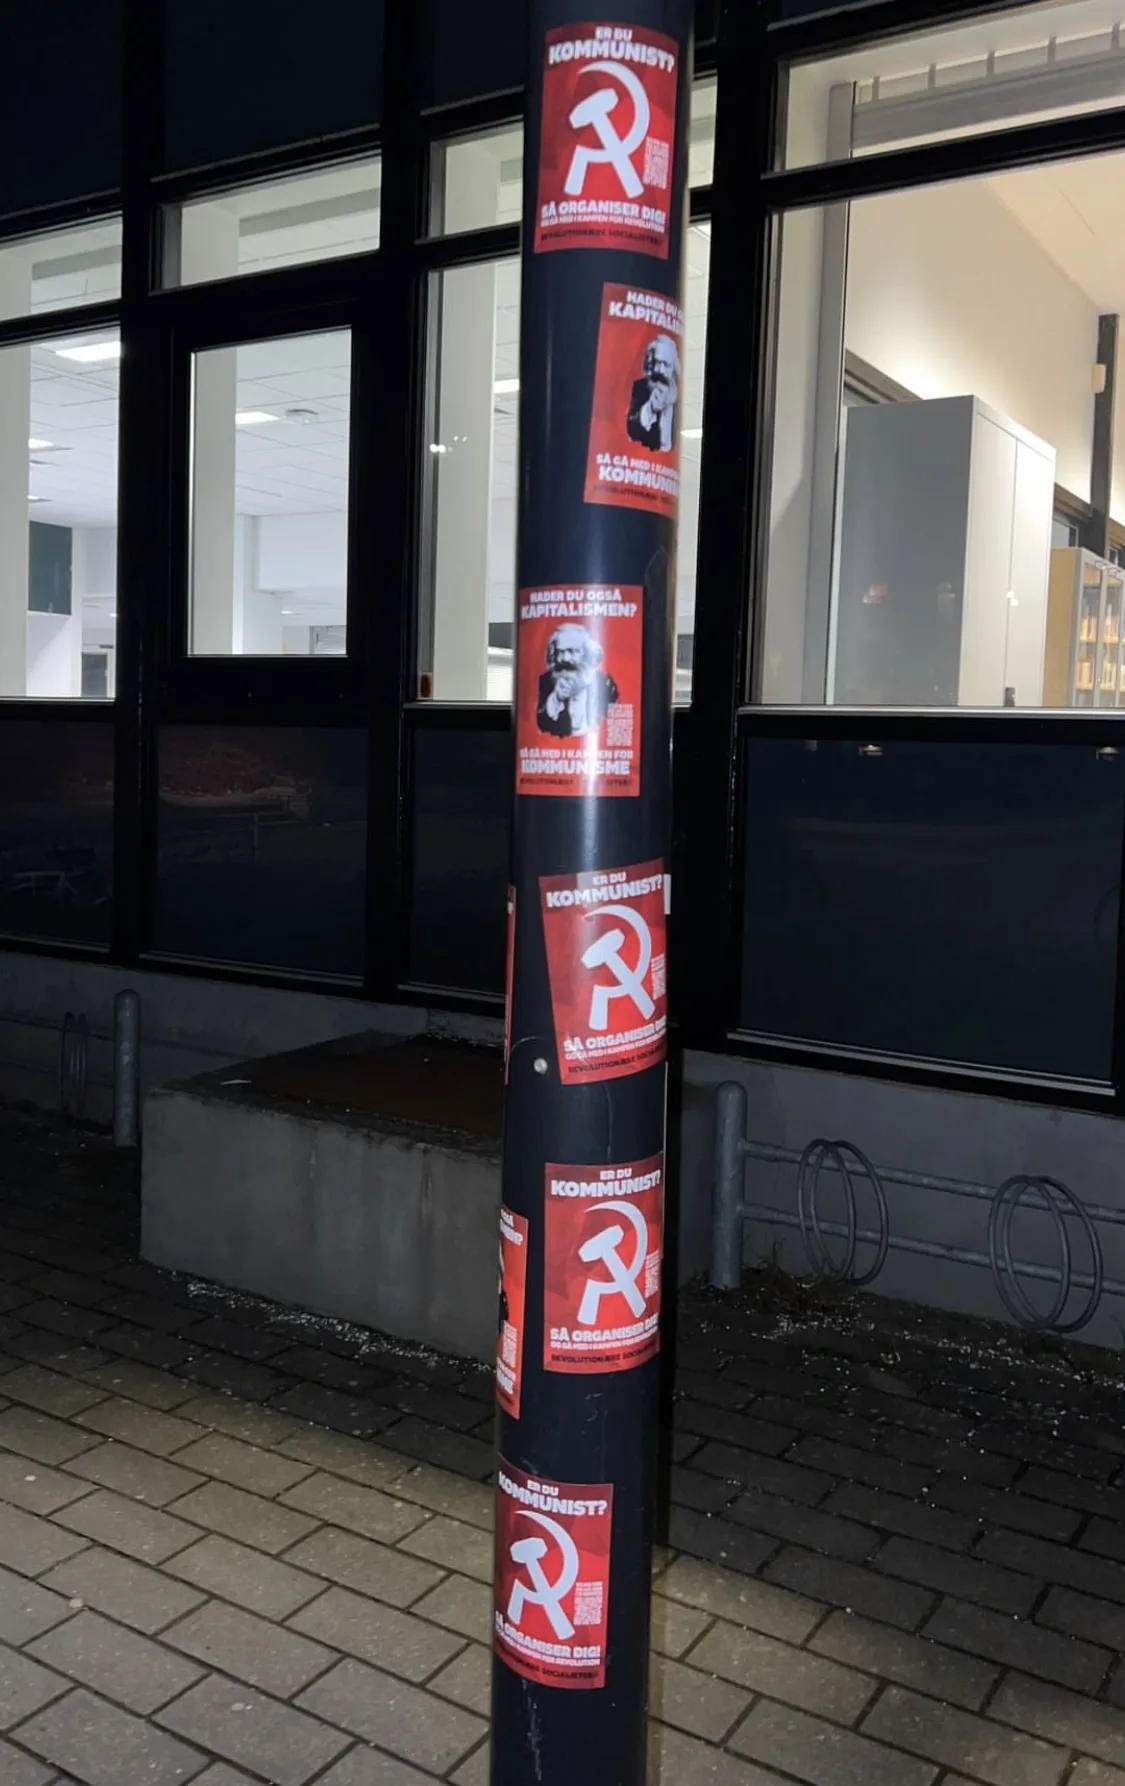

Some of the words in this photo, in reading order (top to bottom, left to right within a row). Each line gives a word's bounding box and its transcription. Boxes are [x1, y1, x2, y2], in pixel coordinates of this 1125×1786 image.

[595, 26, 612, 40] ER
[614, 28, 632, 41] DU
[549, 39, 675, 73] KOMMUNIST?
[541, 200, 556, 219] SÅ
[558, 200, 639, 218] ORGANISER
[627, 290, 665, 312] HADER
[596, 452, 611, 465] SÅ
[613, 455, 629, 467] GÅ
[530, 589, 564, 604] HADER
[566, 589, 584, 602] DU
[586, 588, 622, 601] OGSÅ
[521, 602, 637, 620] KAPITALISMEN?
[568, 748, 612, 760] KAEN
[521, 759, 630, 776] KOMMUNSME
[593, 875, 608, 886] ER
[610, 872, 626, 883] DU
[547, 874, 662, 908] KOMMUNIST?
[564, 1036, 584, 1052] SÅ
[586, 1023, 655, 1050] ORGANISER
[600, 1170, 615, 1180] ER
[617, 1167, 632, 1178] DU
[551, 1169, 661, 1197] KOMMUNIST?
[551, 1327, 570, 1341] SÅ
[572, 1321, 644, 1342] ORGANISER
[499, 1471, 607, 1516] KOMMUNIST?
[527, 1480, 541, 1492] ER
[542, 1484, 559, 1496] DU
[504, 1622, 571, 1658] ORGANISER
[573, 1645, 600, 1657] DIG!
